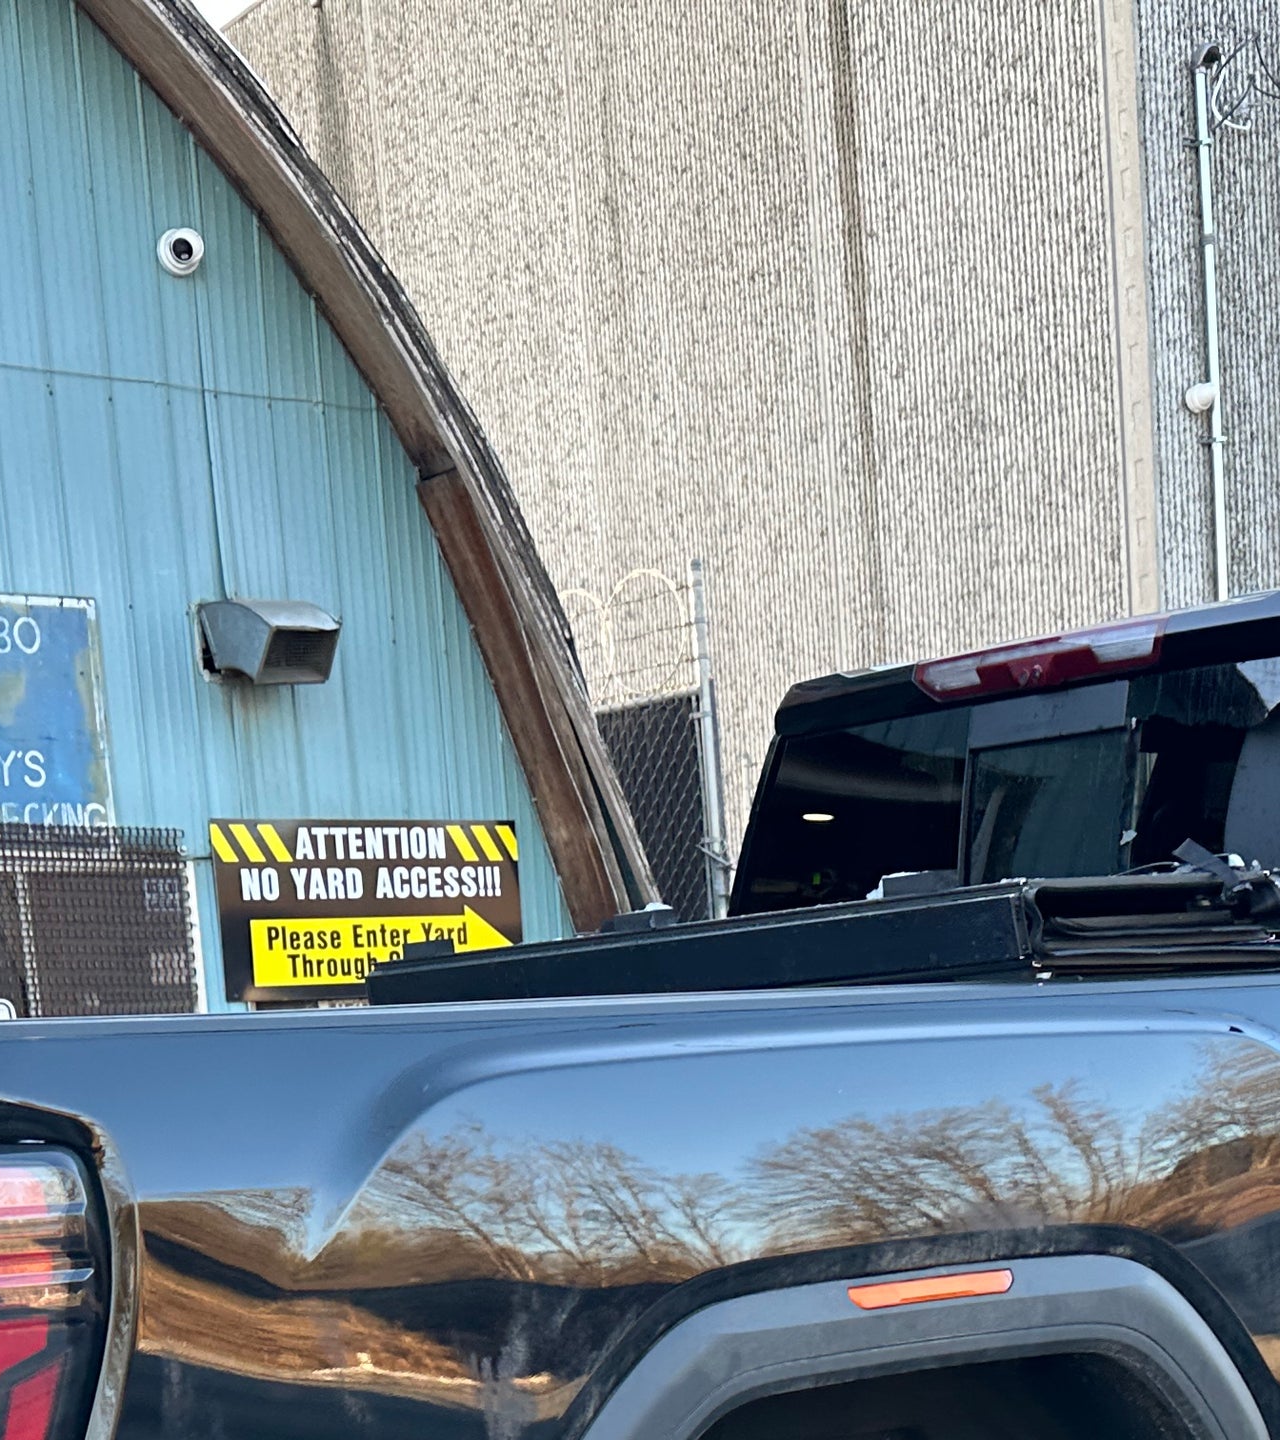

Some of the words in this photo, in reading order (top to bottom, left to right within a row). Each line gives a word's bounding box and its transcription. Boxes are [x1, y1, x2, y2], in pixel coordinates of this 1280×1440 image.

[295, 825, 447, 860] ATTENTION
[240, 868, 280, 901] NO
[290, 867, 364, 900] YARD
[376, 865, 502, 898] ACCESS!!!
[267, 926, 342, 951] Please
[353, 923, 411, 948] Enter
[421, 922, 468, 945] Yard
